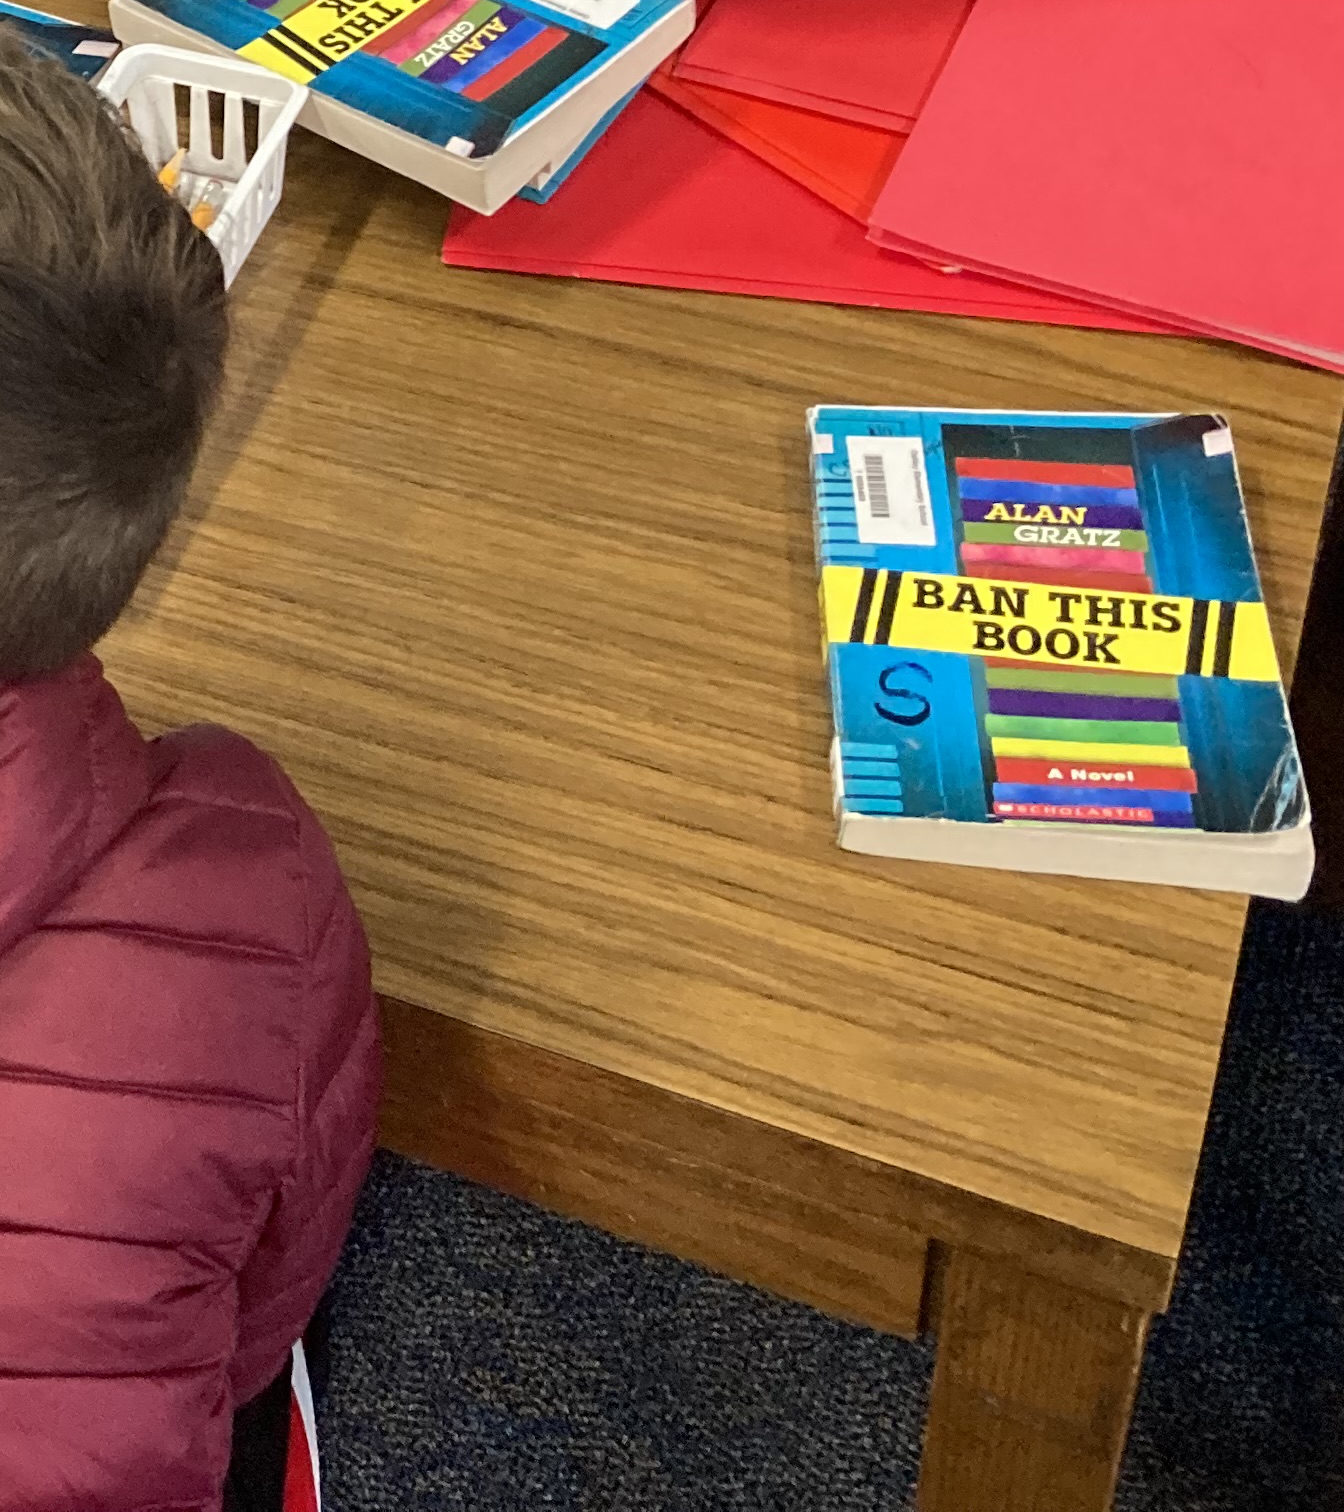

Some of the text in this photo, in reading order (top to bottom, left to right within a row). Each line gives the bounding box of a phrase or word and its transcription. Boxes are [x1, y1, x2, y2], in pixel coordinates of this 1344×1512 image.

[318, 2, 405, 55] THIS
[413, 20, 475, 68] GRATZ
[449, 16, 508, 66] ALAN
[984, 502, 1087, 525] ALAN
[1013, 525, 1121, 547] GRATZ
[912, 578, 1182, 634] BAN THIS
[972, 620, 1120, 664] BOOK
[874, 661, 933, 726] S
[1047, 768, 1135, 783] A Novel
[1019, 804, 1150, 820] SCHOLASTIC
